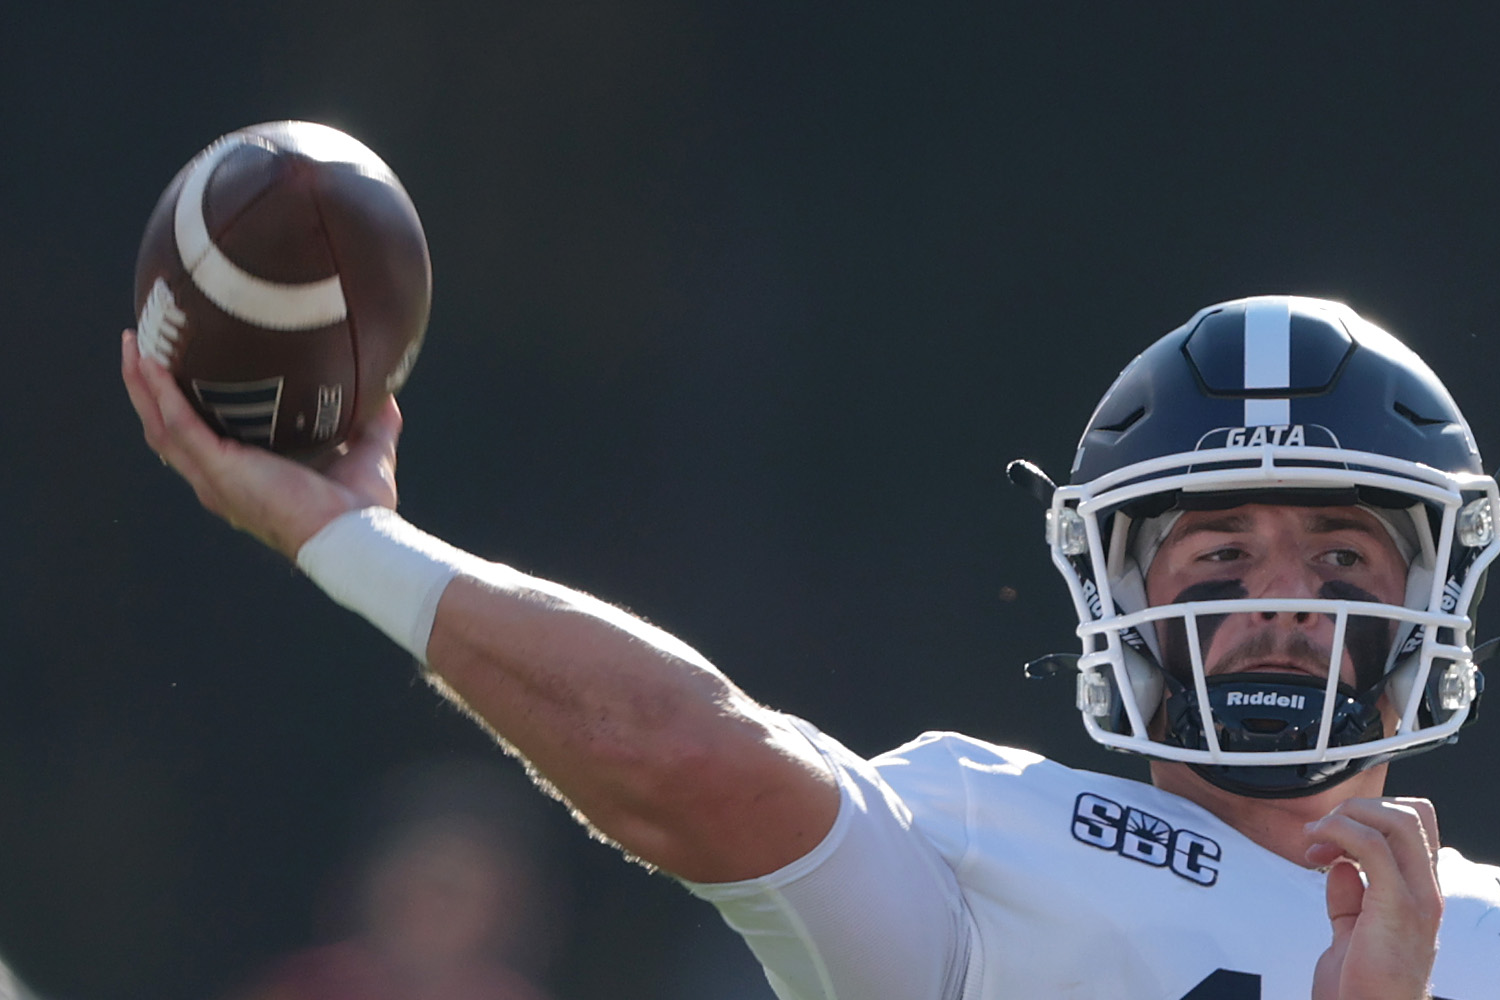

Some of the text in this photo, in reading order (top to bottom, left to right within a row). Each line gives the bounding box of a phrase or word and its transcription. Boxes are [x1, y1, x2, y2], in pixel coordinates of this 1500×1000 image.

[1226, 425, 1306, 448] GATA
[1226, 691, 1306, 710] Riddell
[1071, 792, 1222, 888] SBC
